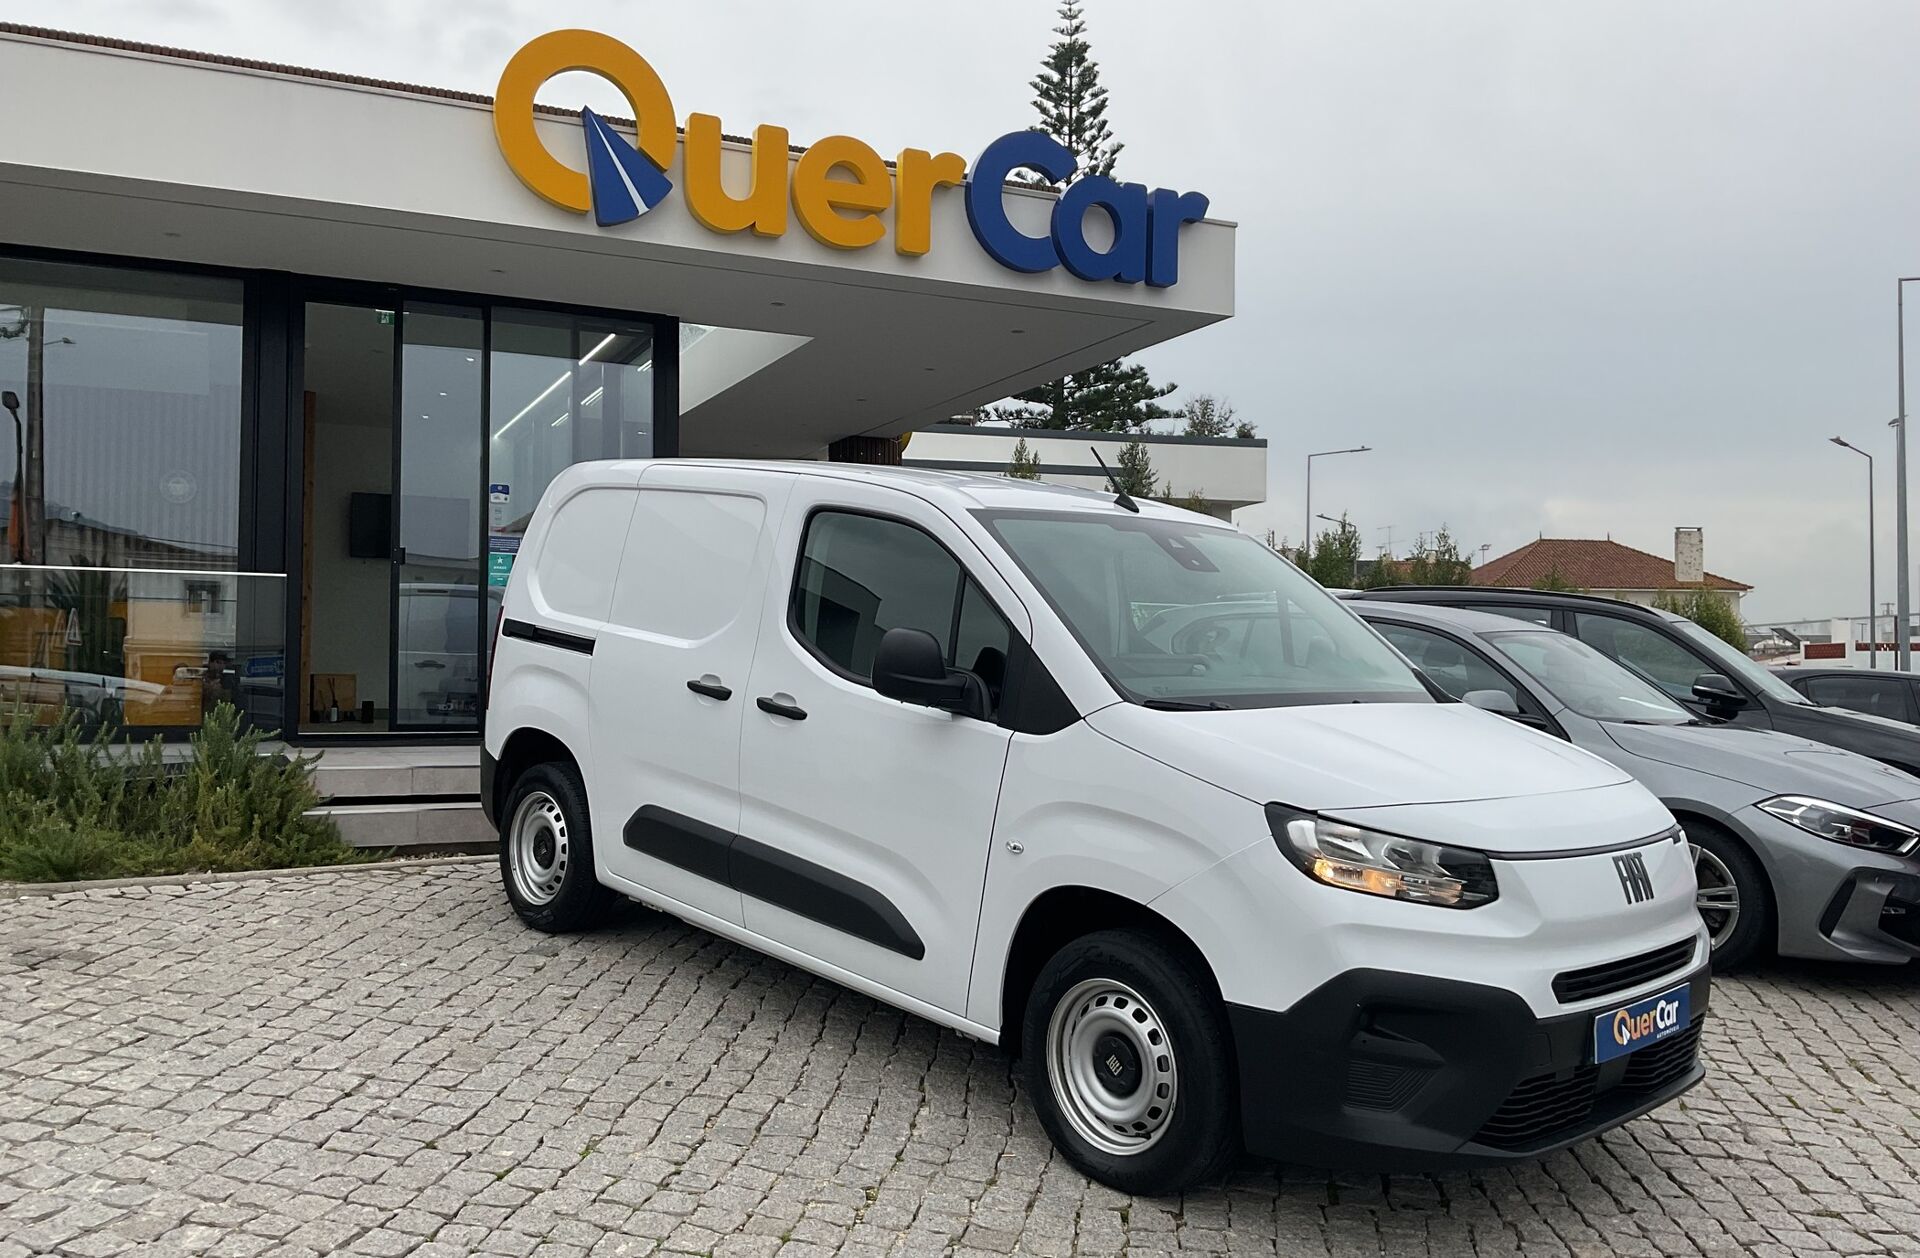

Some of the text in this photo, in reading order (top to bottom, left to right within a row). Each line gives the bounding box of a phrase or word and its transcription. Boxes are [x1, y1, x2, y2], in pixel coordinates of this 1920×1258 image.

[494, 29, 1209, 288] QuerCar
[1612, 852, 1654, 904] FIAT
[1614, 1000, 1679, 1046] QuerCar
[1105, 1054, 1123, 1076] FIAT
